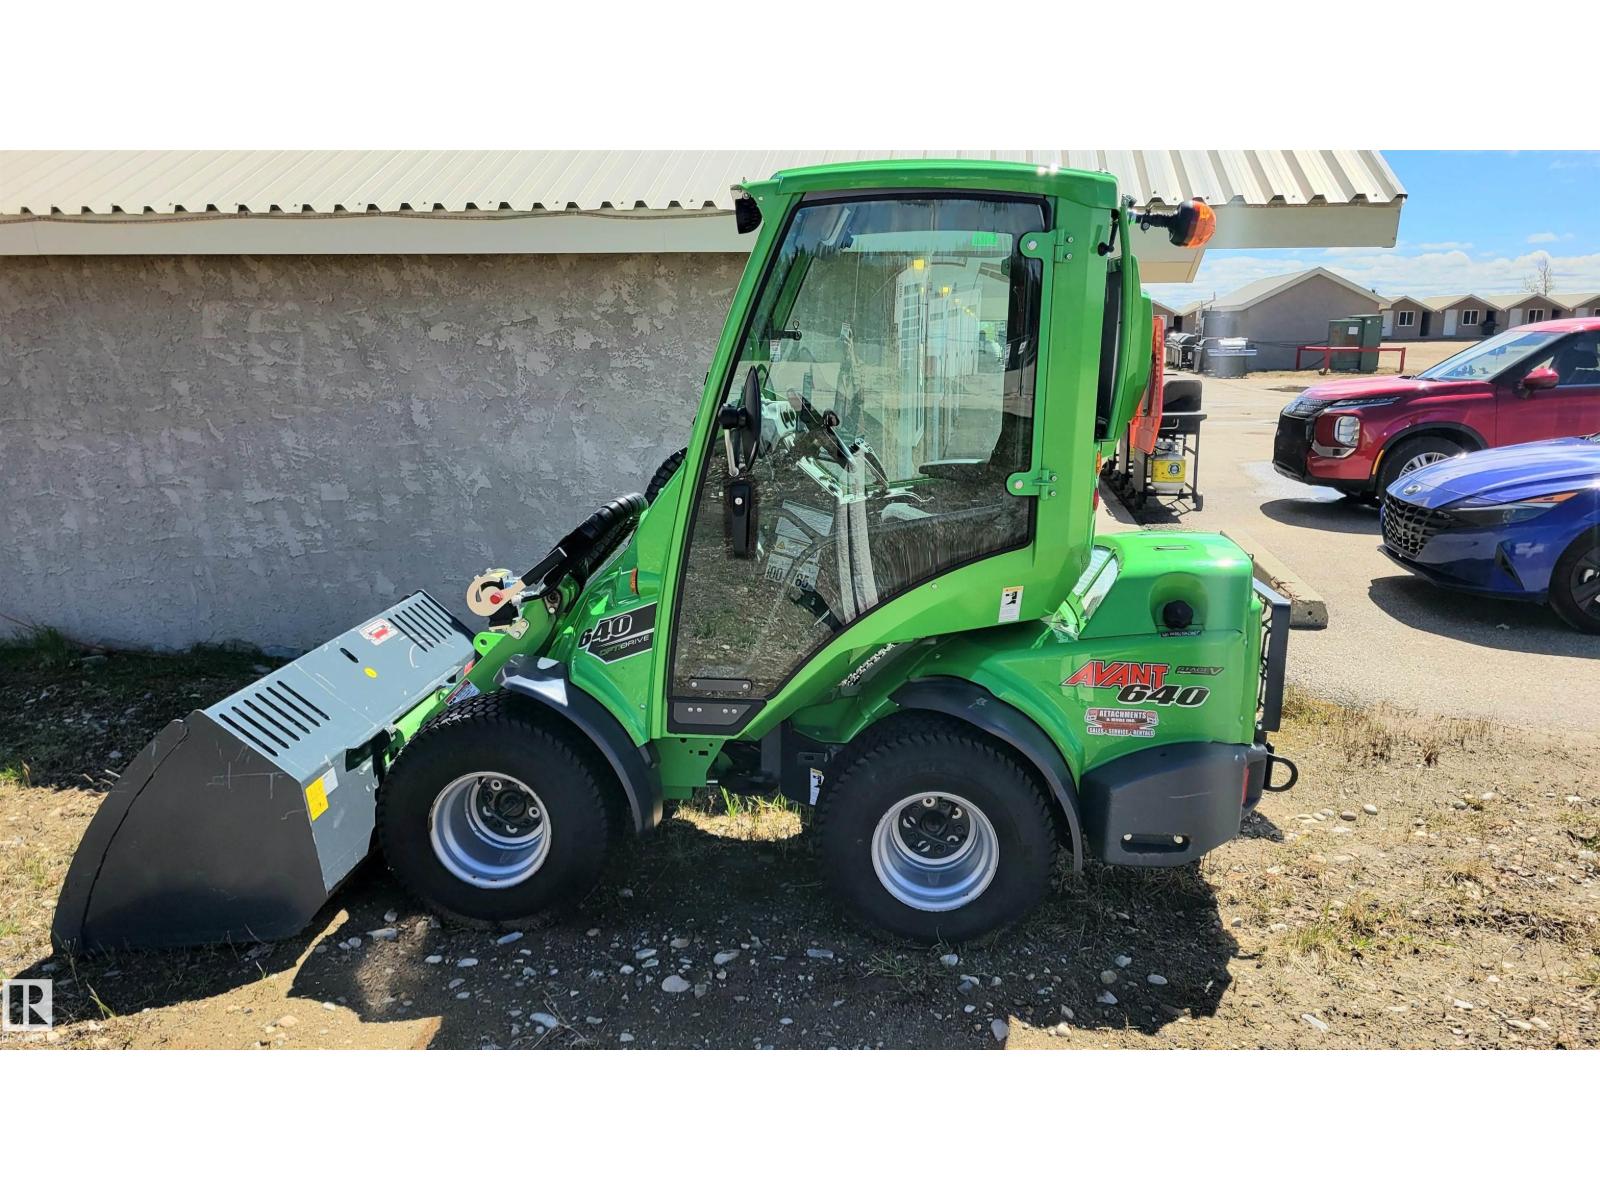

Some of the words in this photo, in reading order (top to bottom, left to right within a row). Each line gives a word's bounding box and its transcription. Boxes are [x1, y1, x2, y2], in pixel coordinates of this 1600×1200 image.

[577, 614, 632, 649] 640
[1059, 659, 1169, 692] AVANT
[1116, 684, 1210, 708] 640
[1099, 709, 1147, 719] ATTACHMENTS
